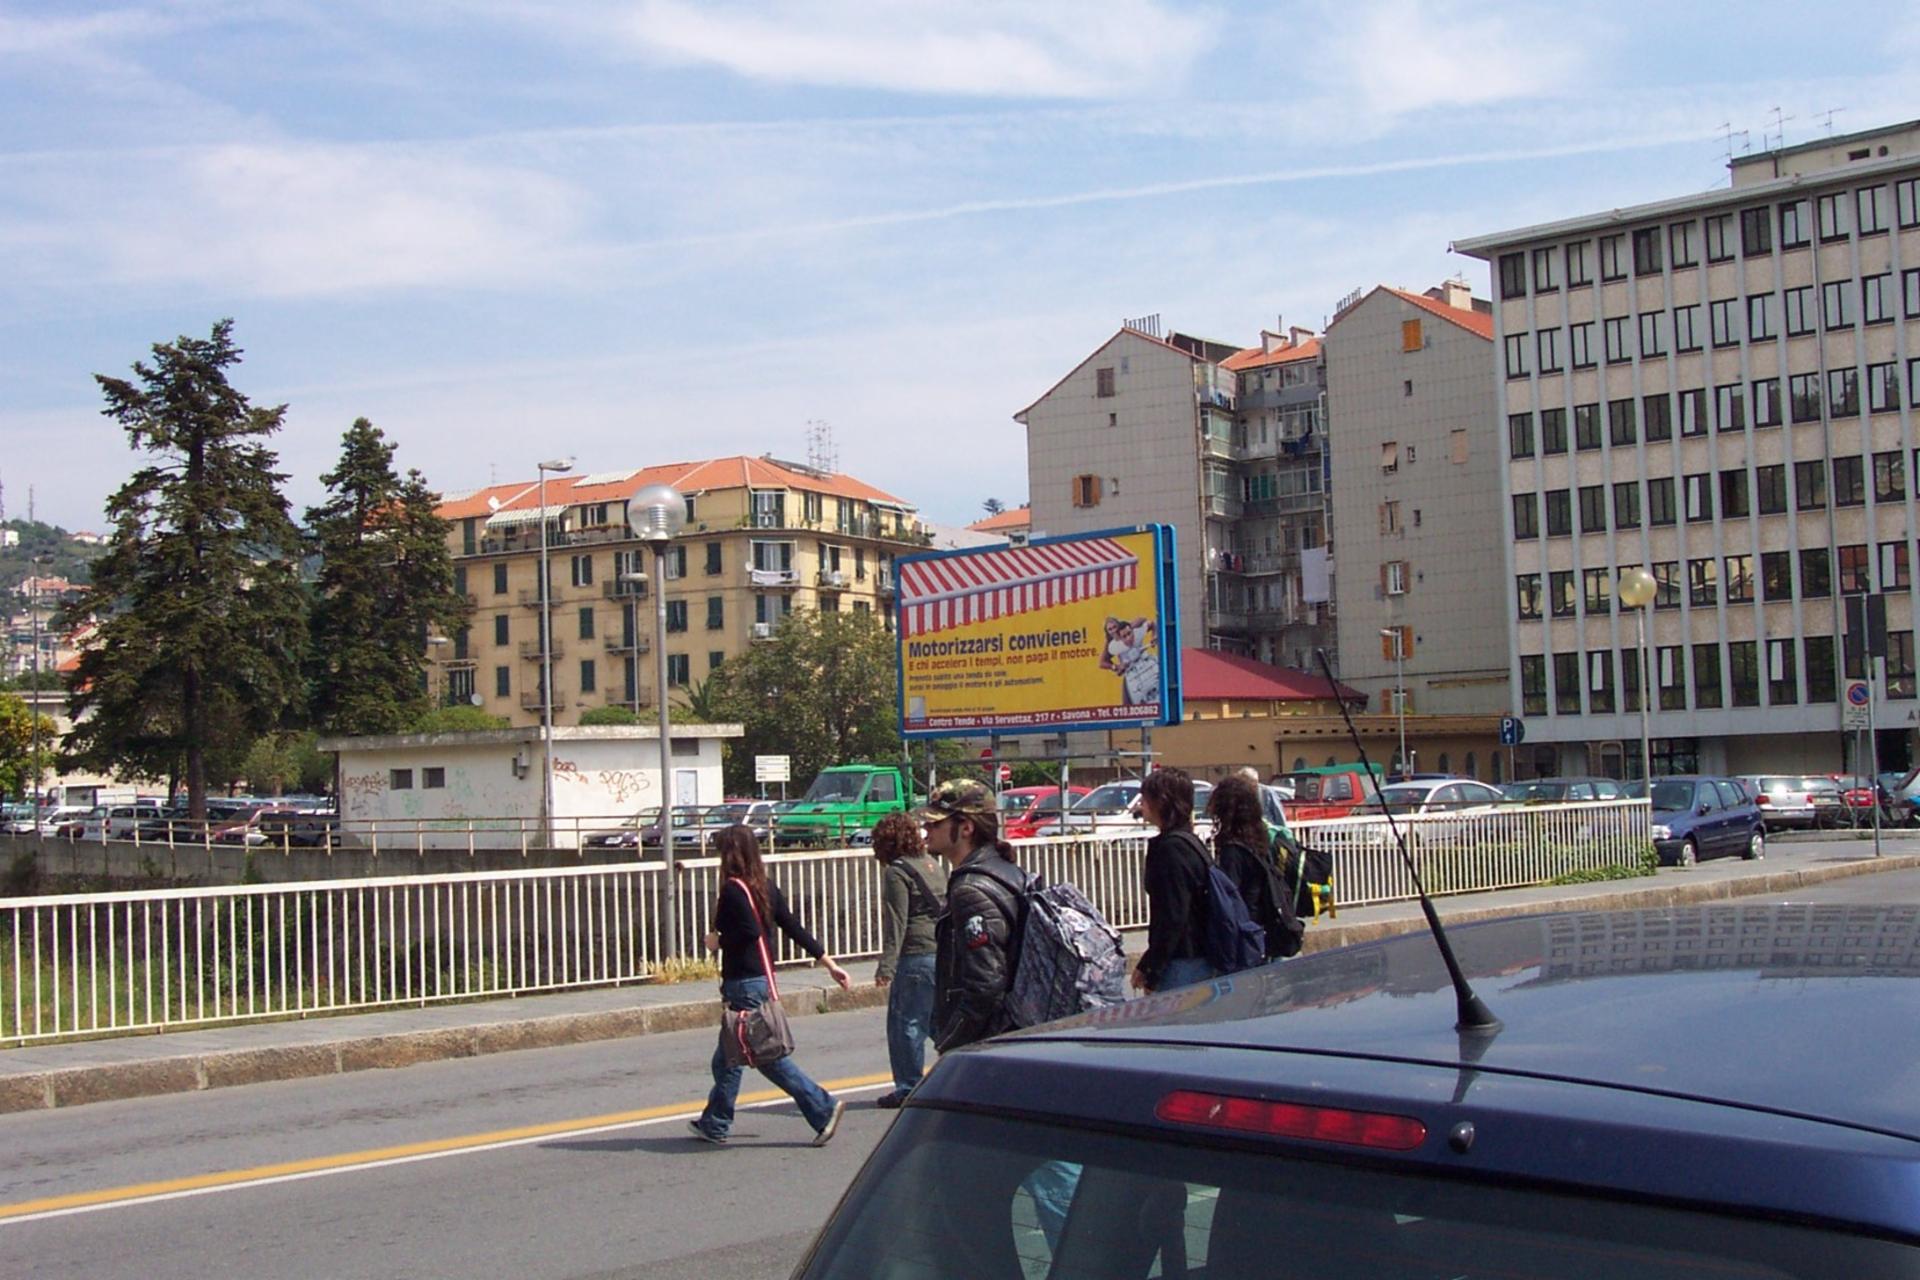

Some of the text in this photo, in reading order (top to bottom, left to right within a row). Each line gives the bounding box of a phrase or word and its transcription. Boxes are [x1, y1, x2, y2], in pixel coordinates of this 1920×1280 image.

[909, 627, 1086, 657] Motorizzarsi conviene!
[909, 661, 914, 671] E
[916, 659, 929, 670] chi
[931, 658, 967, 670] accelera
[1006, 655, 1023, 664] non
[1026, 653, 1049, 664] paga
[1051, 650, 1058, 660] il
[1060, 647, 1099, 660] motore.
[929, 718, 952, 727] Centro
[954, 717, 975, 726] Tende
[981, 716, 993, 725] Via
[1035, 713, 1048, 722] 217
[1062, 710, 1090, 720] Savona
[1097, 708, 1112, 718] Tel.
[1503, 719, 1513, 732] P
